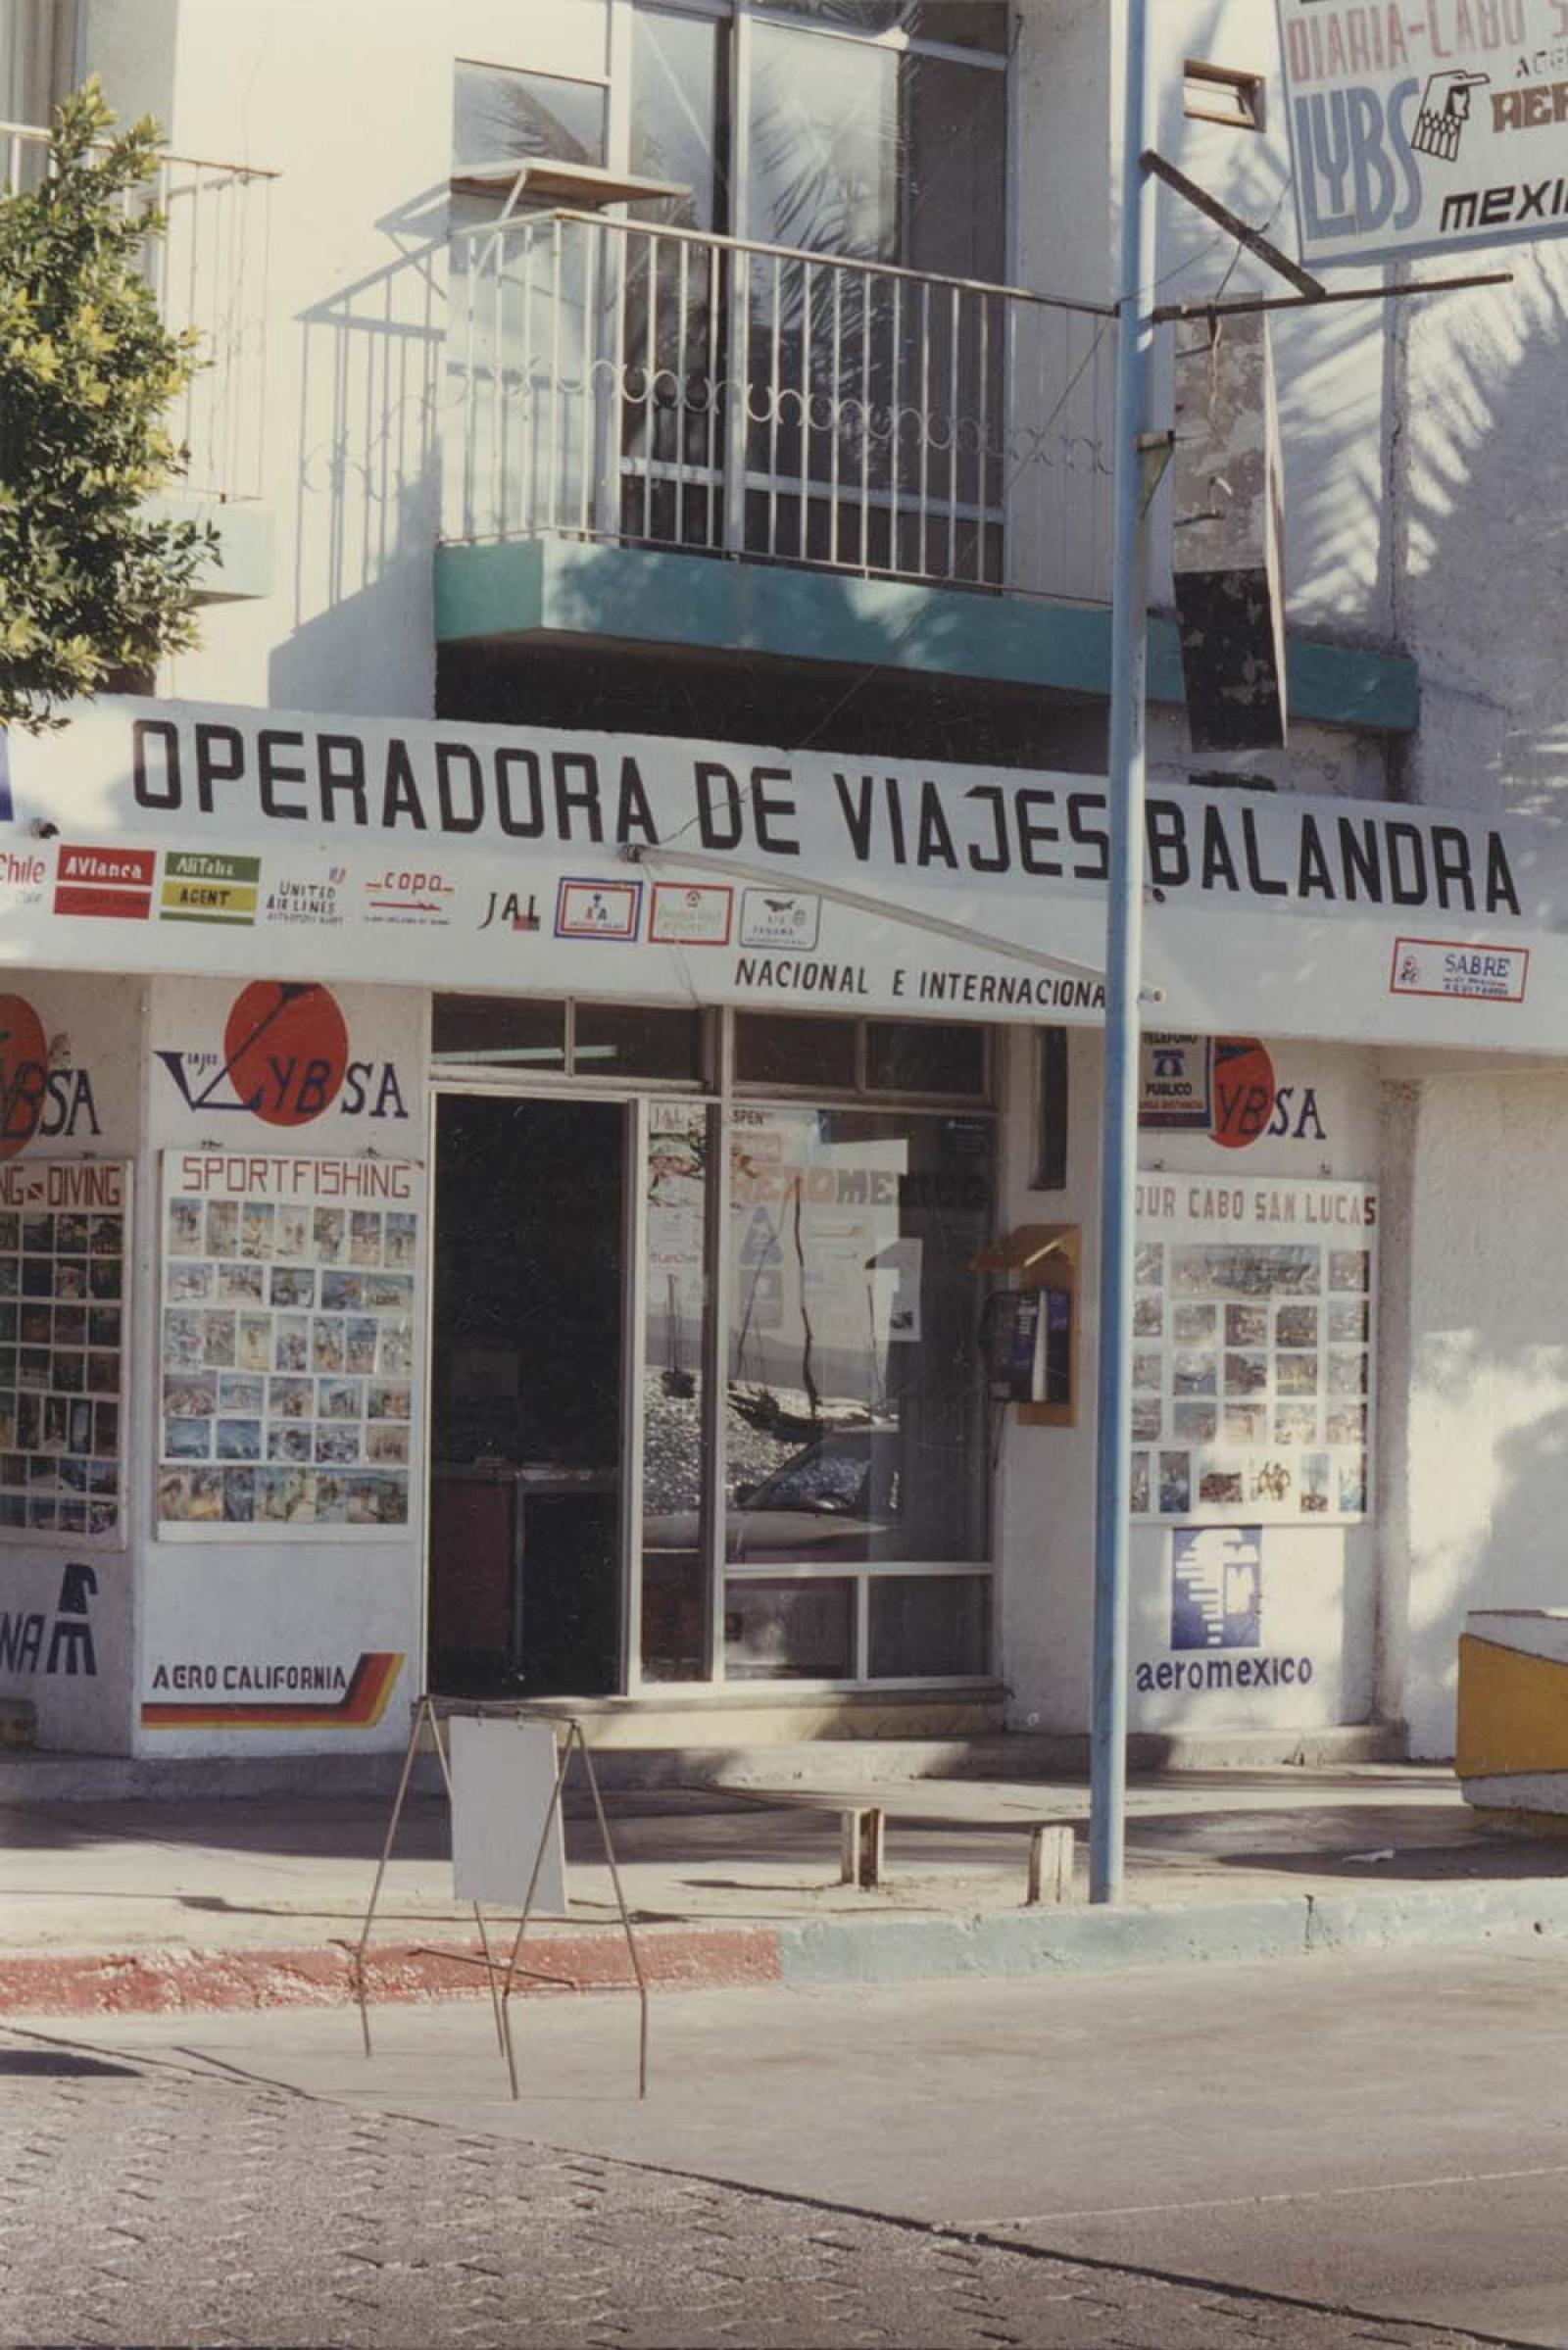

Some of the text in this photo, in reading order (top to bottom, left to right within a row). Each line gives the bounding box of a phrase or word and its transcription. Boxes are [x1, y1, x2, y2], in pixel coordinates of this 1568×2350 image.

[133, 719, 1522, 915] OPERADORA DE VIAJES BALANDRA
[478, 892, 541, 929] JAL
[734, 957, 1107, 1009] NACIONAL E INTERNACIONA
[1445, 953, 1510, 977] SABRE
[49, 1166, 121, 1207] DIVING
[182, 1156, 414, 1199] SPORTFISHING
[1188, 1188, 1244, 1222] CABO
[1254, 1192, 1297, 1223] SAN
[1304, 1195, 1377, 1226] LUCAS
[152, 1664, 347, 1690] AERO CALIFORNIA
[1135, 1656, 1313, 1691] aeromexico
